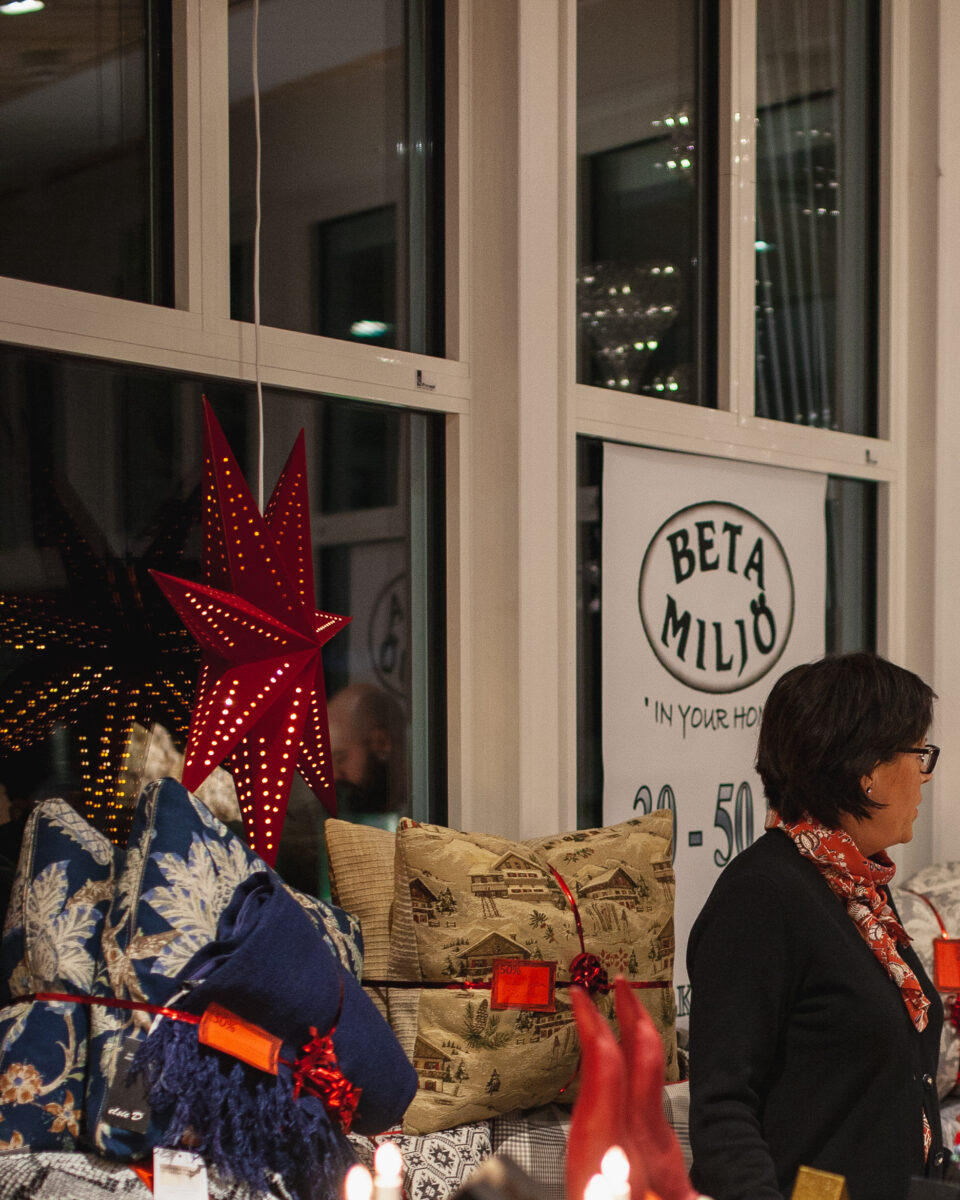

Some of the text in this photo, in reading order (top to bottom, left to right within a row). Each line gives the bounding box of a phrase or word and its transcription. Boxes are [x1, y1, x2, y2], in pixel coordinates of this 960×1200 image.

[666, 520, 767, 592] BETA
[661, 588, 777, 677] MILJÖ
[678, 703, 730, 739] YOUR
